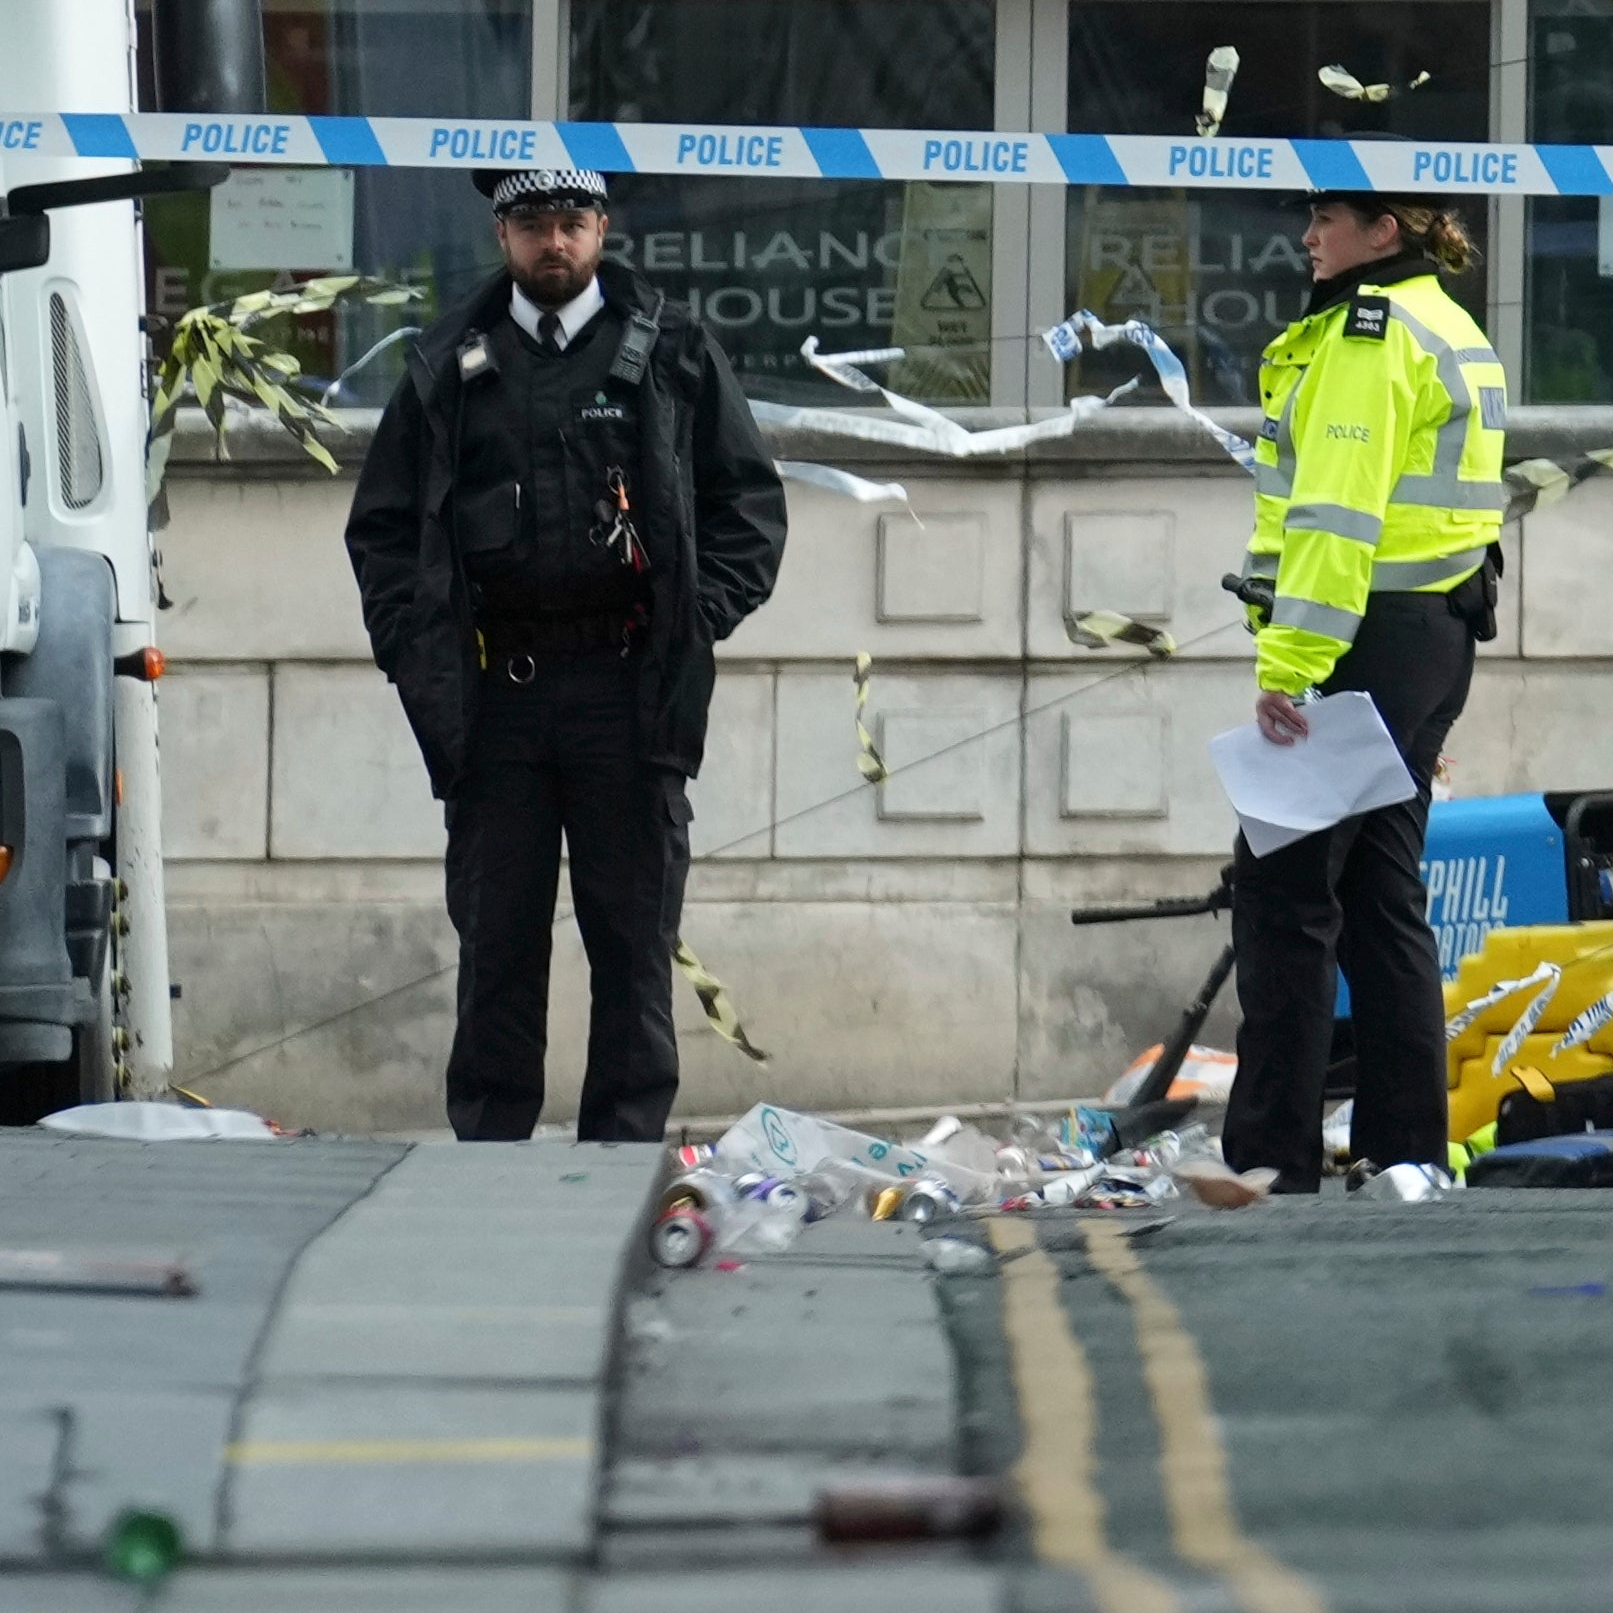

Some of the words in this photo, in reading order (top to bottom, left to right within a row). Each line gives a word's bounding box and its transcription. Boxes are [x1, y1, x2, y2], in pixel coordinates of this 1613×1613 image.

[0, 120, 44, 150] ICE
[182, 123, 293, 157] POLICE
[429, 128, 540, 163] POLICE
[676, 133, 785, 169] POLICE
[923, 140, 1030, 176] POLICE
[1169, 145, 1276, 180] POLICE
[1414, 151, 1519, 186] POLICE
[602, 231, 922, 272] RELIANC
[1089, 233, 1308, 274] RELIA
[1150, 289, 1312, 328] HOU
[581, 407, 623, 419] POLICE
[1325, 423, 1371, 443] POLICE
[1420, 854, 1508, 924] PHILL
